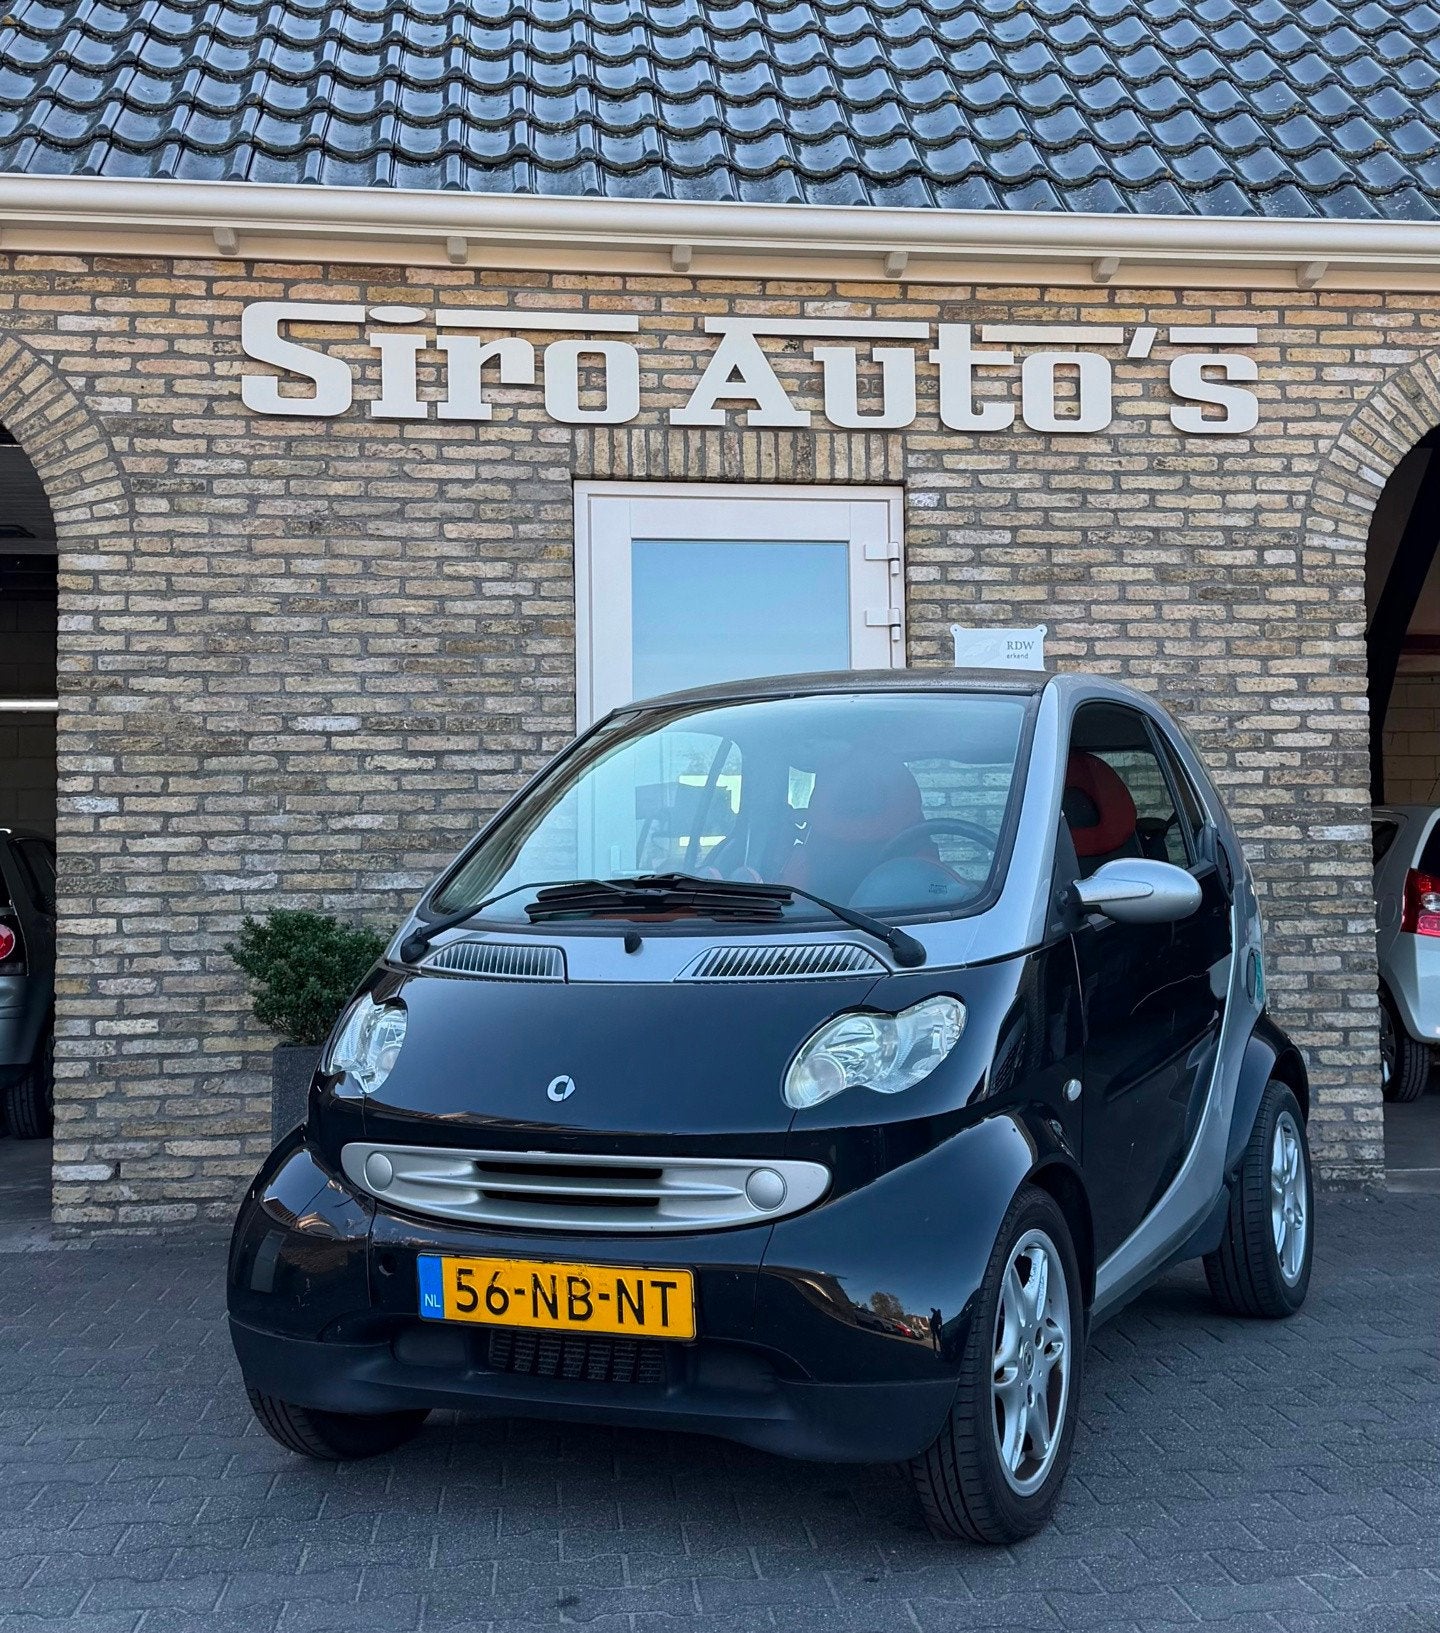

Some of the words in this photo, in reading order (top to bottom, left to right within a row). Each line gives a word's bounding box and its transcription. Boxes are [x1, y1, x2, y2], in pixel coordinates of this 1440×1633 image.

[241, 301, 639, 424] Siro
[669, 317, 1259, 434] Auto's
[1007, 641, 1034, 650] RDW
[424, 1293, 441, 1308] NL
[456, 1267, 677, 1327] 56-NB-NT
